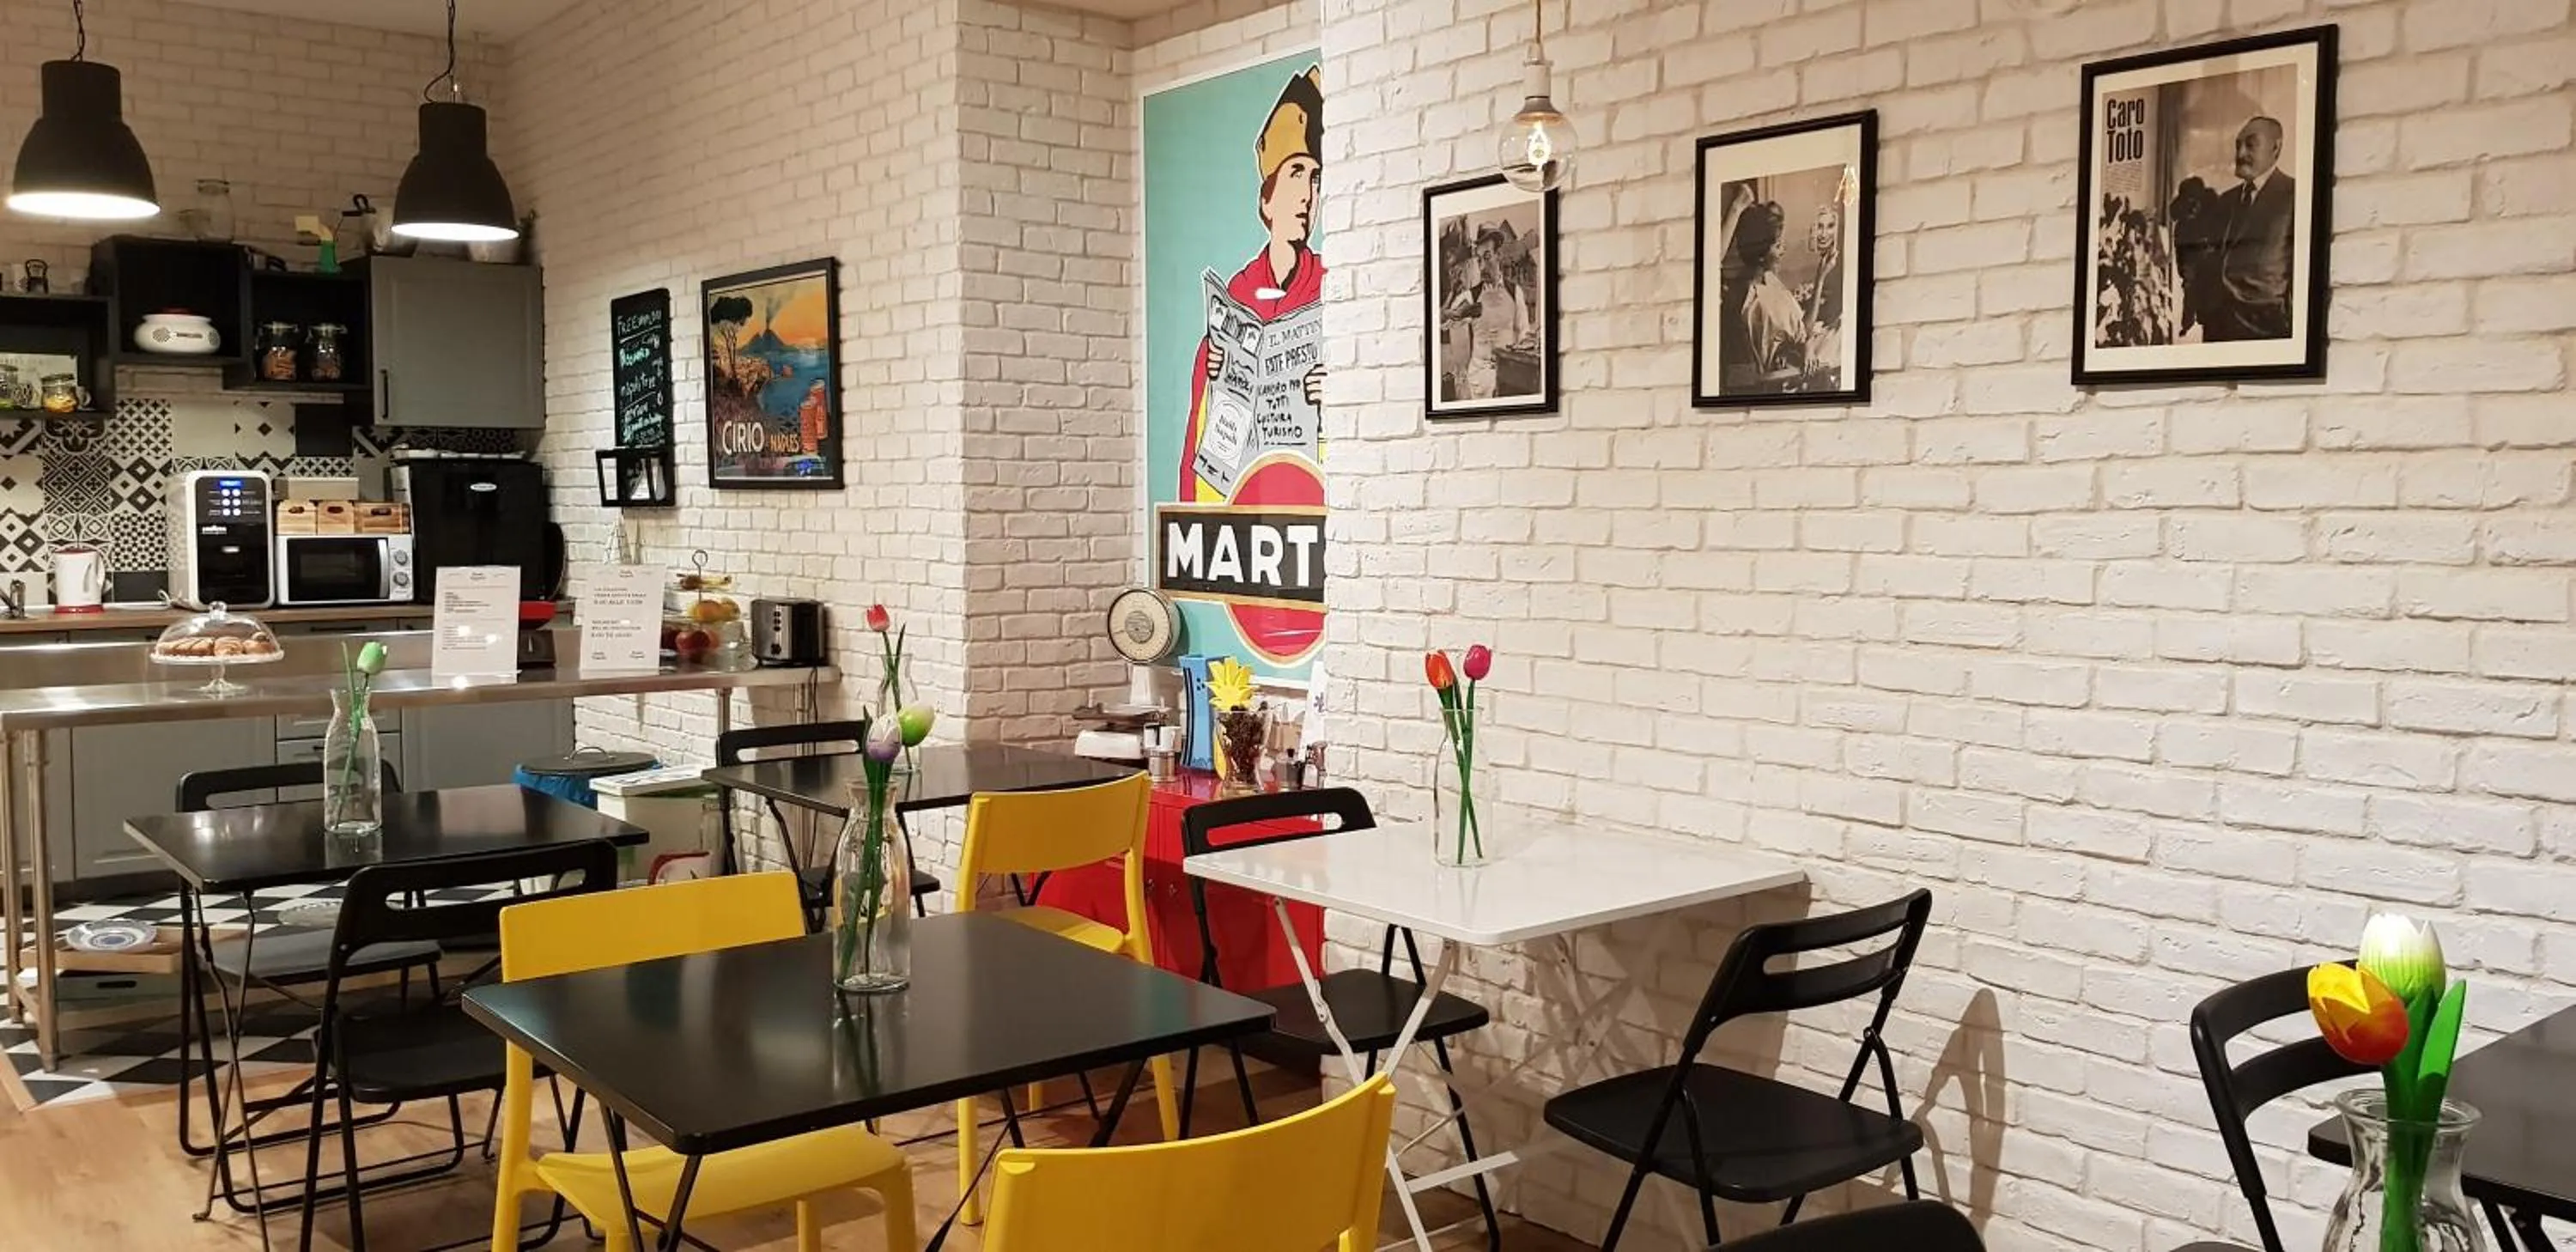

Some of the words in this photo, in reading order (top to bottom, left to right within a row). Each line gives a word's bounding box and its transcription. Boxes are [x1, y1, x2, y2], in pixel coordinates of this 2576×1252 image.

[2107, 99, 2144, 129] Caro
[2106, 128, 2143, 163] Toto
[722, 421, 765, 455] CIRIO
[1167, 522, 1318, 587] MART
